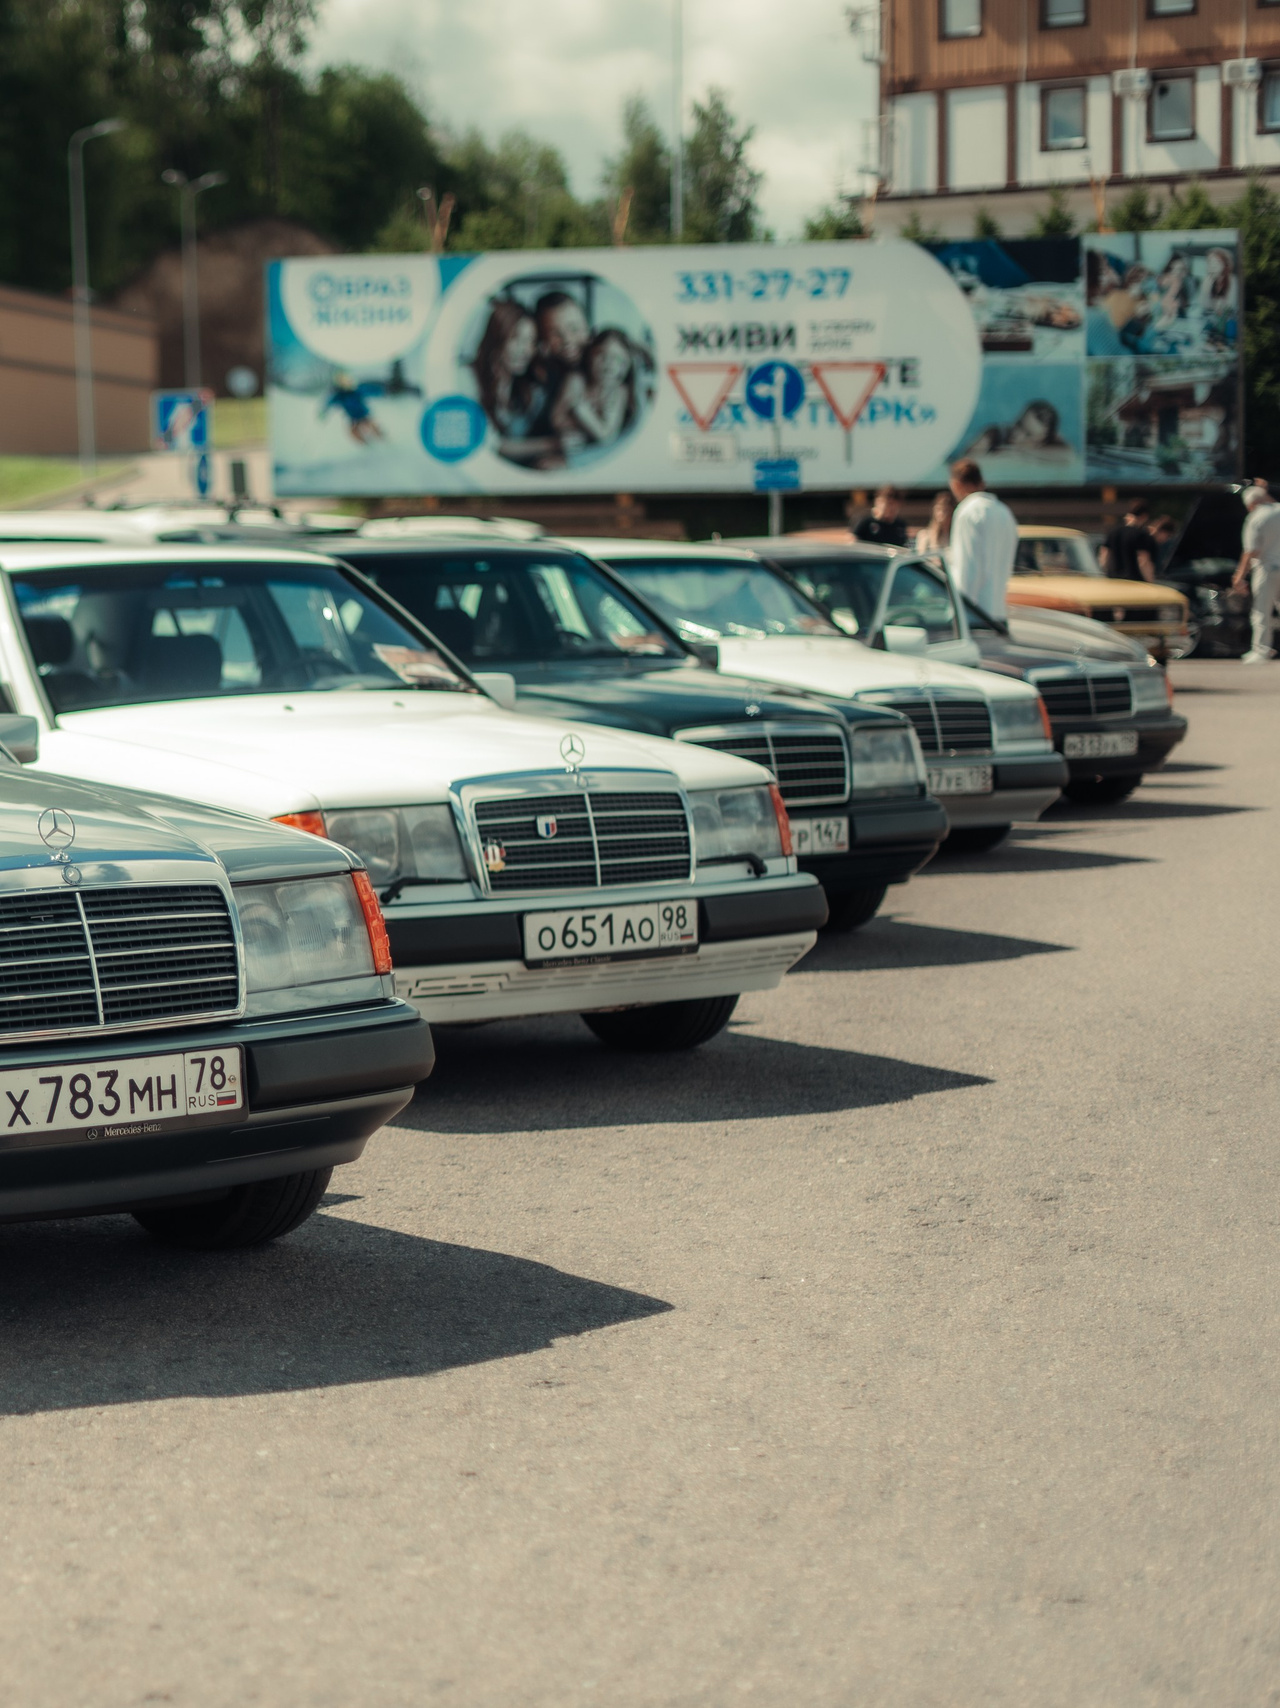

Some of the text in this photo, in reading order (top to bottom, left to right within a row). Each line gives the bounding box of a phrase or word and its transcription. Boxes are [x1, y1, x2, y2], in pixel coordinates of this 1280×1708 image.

[675, 267, 852, 301] 331-27-27
[677, 321, 797, 353] ЖИВИ
[815, 820, 842, 841] 147
[538, 905, 687, 951] О651АО 98
[661, 931, 680, 942] RUS
[6, 1056, 227, 1127] Х783МН 78
[188, 1094, 216, 1109] RUS
[104, 1123, 163, 1137] Mercedes-Benz
